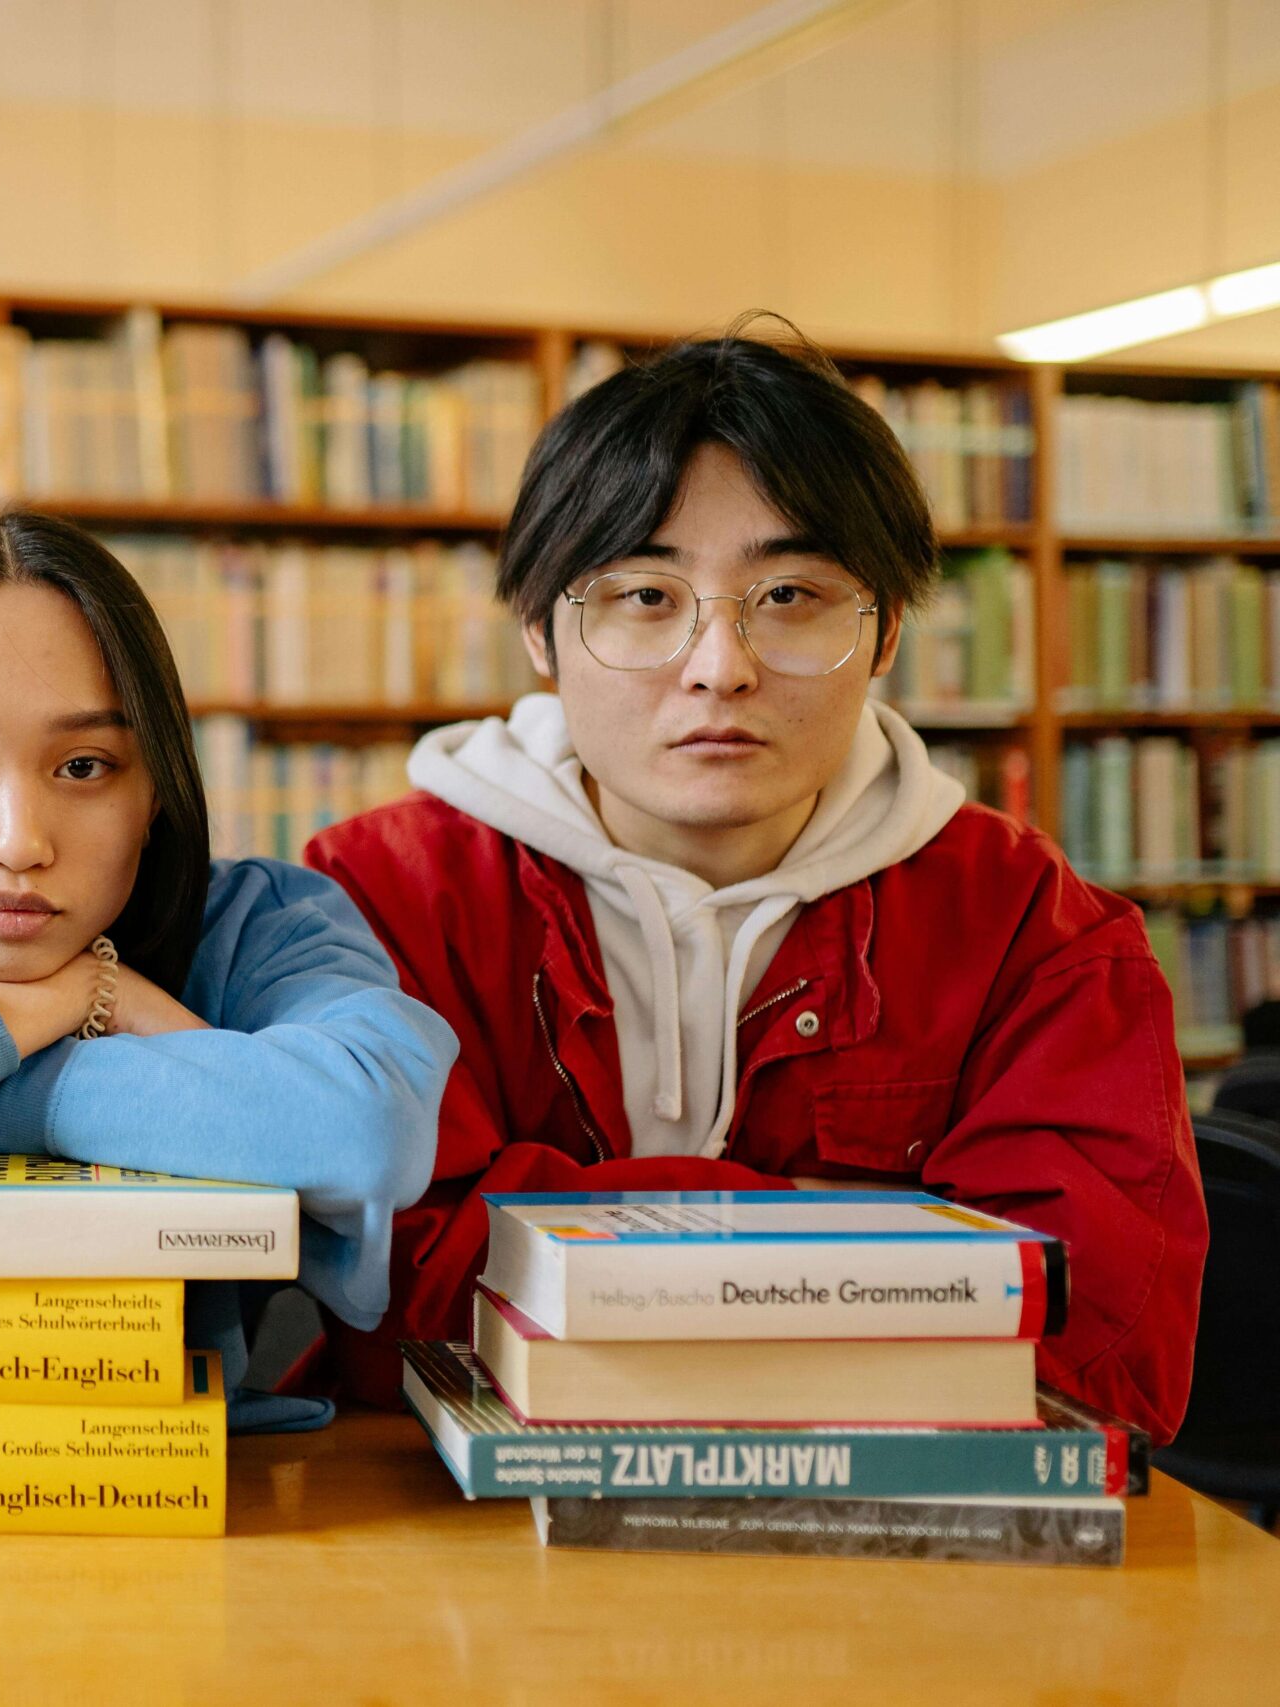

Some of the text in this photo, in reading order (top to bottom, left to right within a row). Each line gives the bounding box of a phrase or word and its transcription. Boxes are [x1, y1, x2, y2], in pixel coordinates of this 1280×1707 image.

[722, 1278, 830, 1305] Deutsche
[838, 1277, 978, 1304] Grammatik
[34, 1292, 162, 1312] Langenscheidts
[19, 1313, 162, 1332] Schulwörterbuch
[81, 1420, 210, 1439] Langenscheidts
[2, 1440, 210, 1458] Großes Schulwörterbuch
[611, 1445, 851, 1486] MARKTPLATZ
[623, 1515, 679, 1529] MEMORIA
[681, 1518, 730, 1530] SILESIAE
[740, 1519, 765, 1531] ZUM
[767, 1520, 825, 1533] GEDENKEN
[827, 1523, 844, 1534] AN
[847, 1523, 889, 1535] MARIAN
